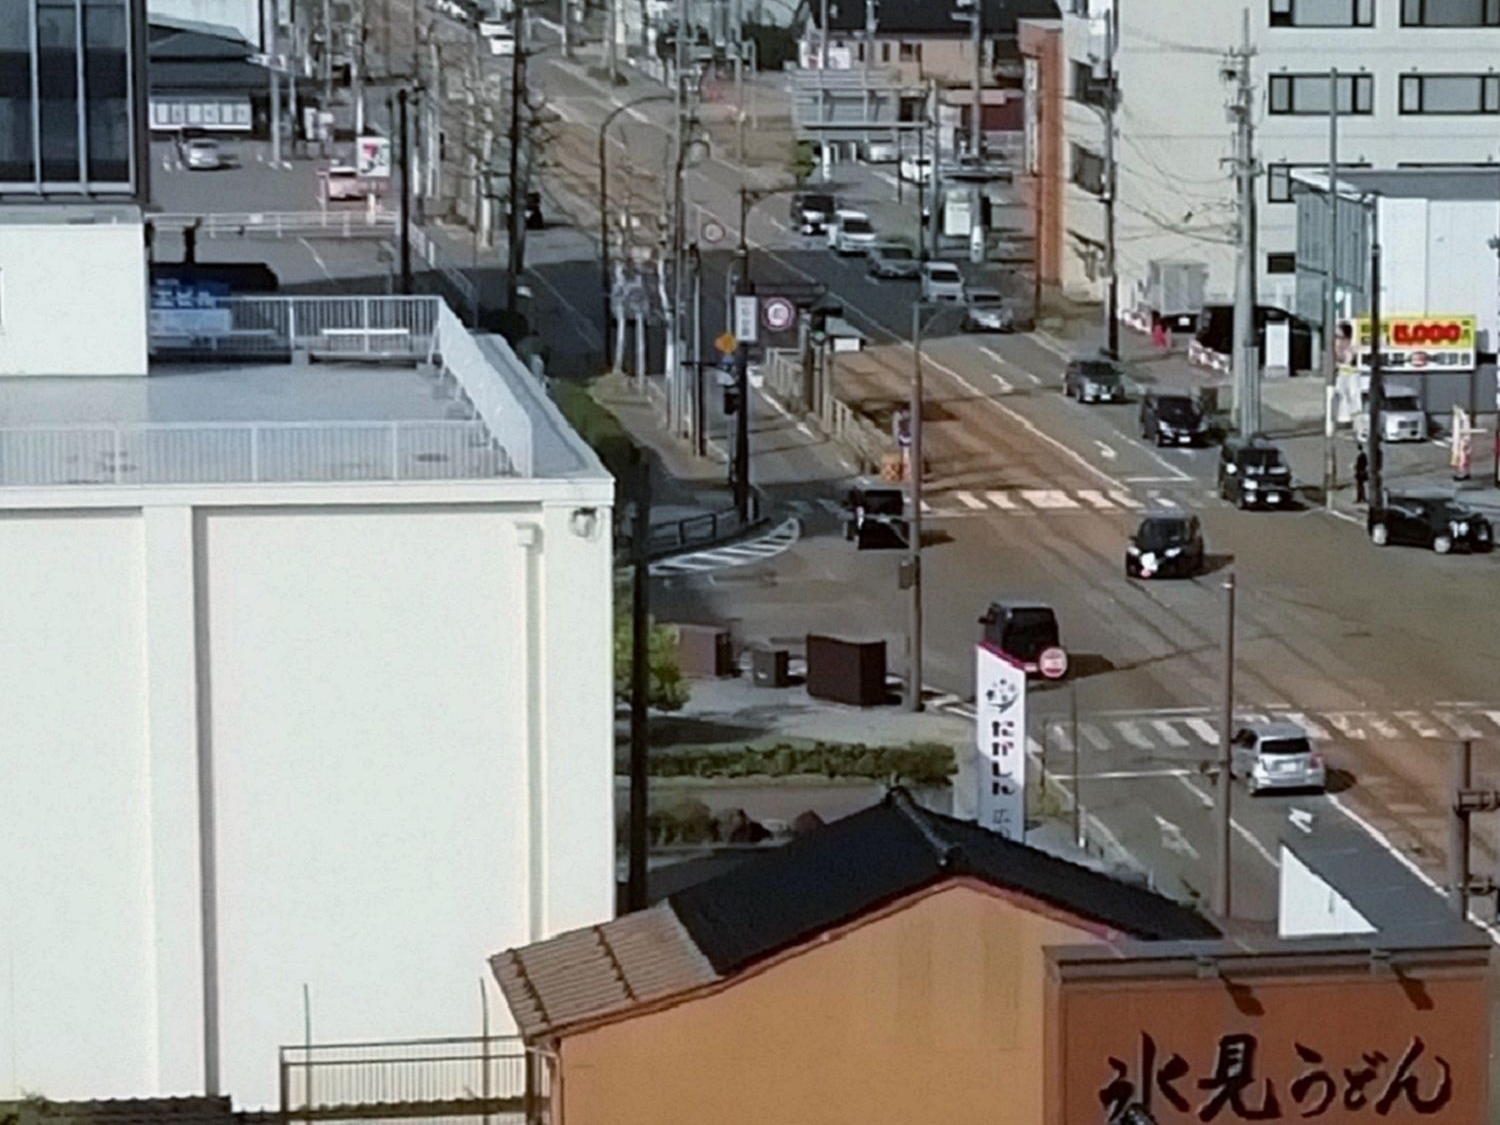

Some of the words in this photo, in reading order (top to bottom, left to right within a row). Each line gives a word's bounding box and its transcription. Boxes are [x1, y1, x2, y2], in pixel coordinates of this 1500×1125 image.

[992, 720, 1016, 796] たかしん
[1098, 1030, 1453, 1124] 氷見うどん
